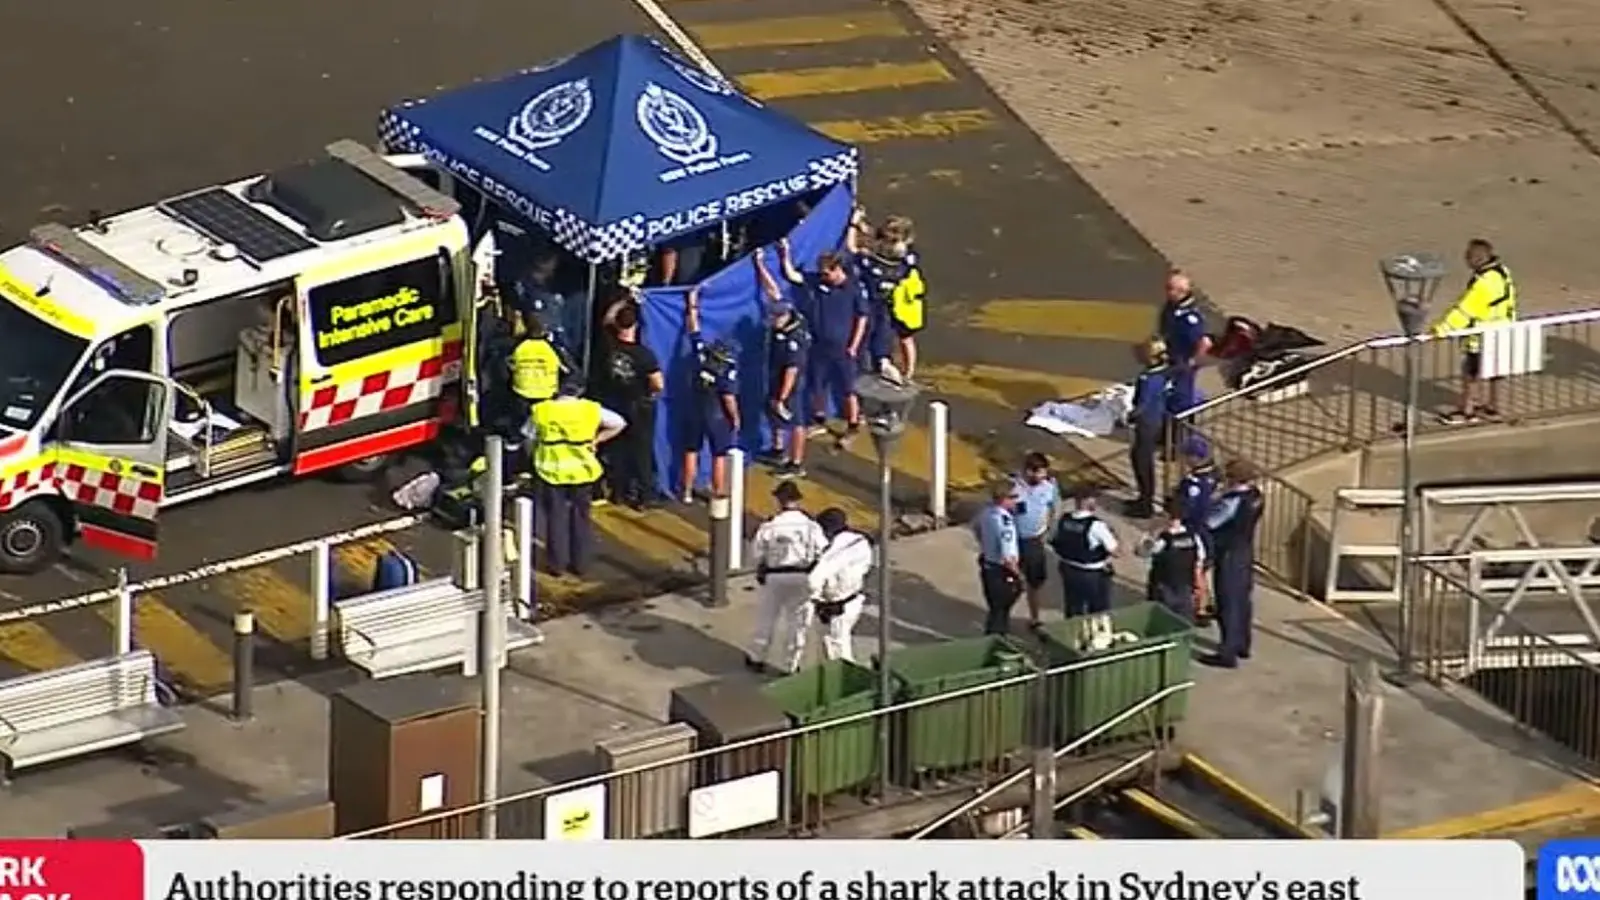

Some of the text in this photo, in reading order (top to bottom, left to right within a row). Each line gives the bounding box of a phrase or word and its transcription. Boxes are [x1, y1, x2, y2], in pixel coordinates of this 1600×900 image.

[482, 176, 553, 228] RESCUE
[646, 174, 809, 240] POLICE RESCUE
[318, 304, 434, 349] Intensive Care
[330, 286, 420, 325] Paramedic
